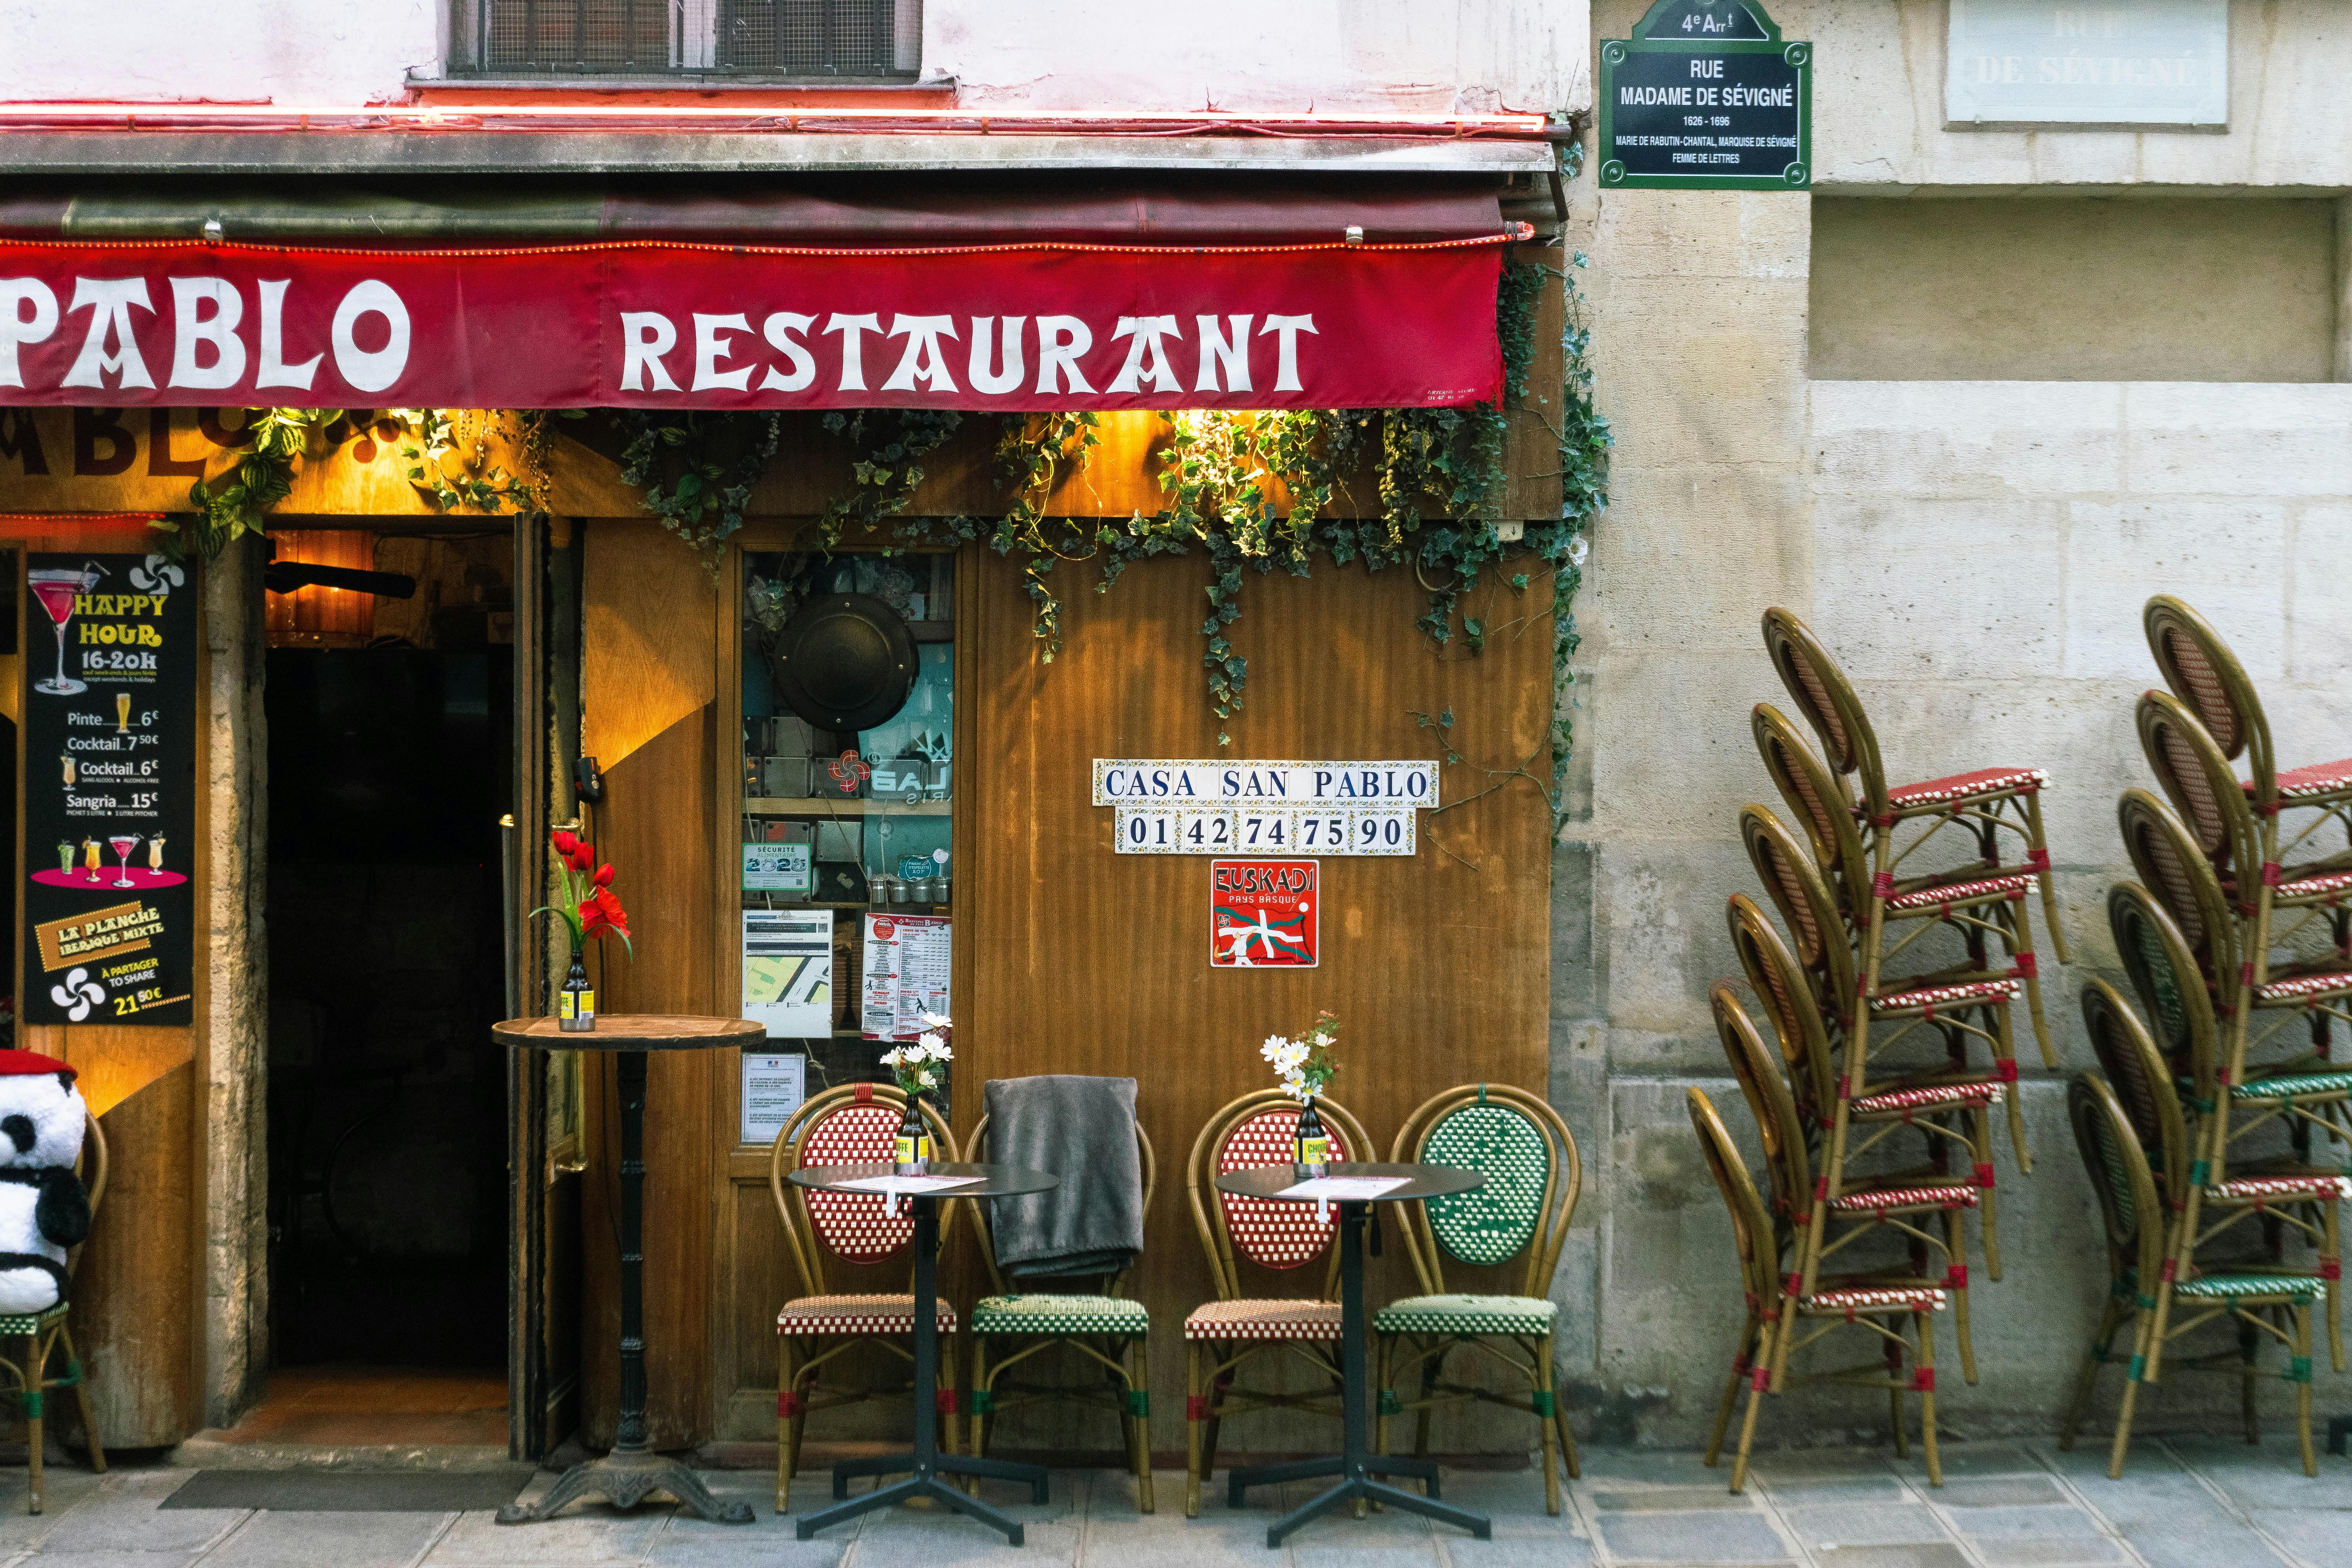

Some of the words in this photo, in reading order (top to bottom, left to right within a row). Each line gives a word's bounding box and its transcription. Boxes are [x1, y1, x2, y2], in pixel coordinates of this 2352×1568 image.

[1690, 60, 1723, 78] RUE
[1980, 56, 2024, 84] DE
[2038, 48, 2197, 86] SÉVIGNÉ
[1621, 87, 1691, 105] MADAME
[1697, 87, 1719, 105] DE
[1722, 83, 1793, 107] SÉVIGNÉ
[1683, 116, 1703, 126] 1626
[1710, 116, 1730, 126] 1696
[1616, 136, 1638, 146] MARIE
[1639, 136, 1650, 146] DE
[1650, 136, 1717, 148] RABUTIN-CHANTAL,
[1719, 137, 1755, 147] MARQUISE
[1756, 137, 1766, 147] DE
[1767, 135, 1796, 147] SÉVIGNÉ
[1673, 153, 1697, 163] FEMME
[1699, 154, 1708, 163] DE
[1709, 154, 1739, 163] LETTRES
[0, 276, 410, 392] PABLO
[619, 311, 1320, 394] RESTAURANT
[73, 595, 168, 616] HAPPY
[79, 624, 162, 647] HOUR
[67, 712, 102, 725] Pinte
[67, 737, 120, 750] Cocktail
[80, 761, 133, 775] Cocktail
[1106, 770, 1196, 797] CASA
[1222, 771, 1289, 797] SAN
[1313, 771, 1427, 798] PABLO
[66, 794, 116, 810] Sangria
[131, 792, 158, 808] 15€
[1130, 817, 1167, 844] 01
[1187, 817, 1228, 844] 42
[1246, 818, 1285, 845] 74
[1304, 819, 1343, 845] 75
[1361, 818, 1400, 845] 90
[746, 858, 807, 872] 2025
[1214, 867, 1315, 894] EUSKADI
[1259, 895, 1297, 904] BASQUE
[58, 926, 81, 942] LA
[84, 907, 160, 936] PLANCHE
[123, 922, 164, 940] MIXTE
[110, 957, 159, 976] PARTAGER
[109, 978, 123, 987] TO
[124, 969, 156, 984] SHARE
